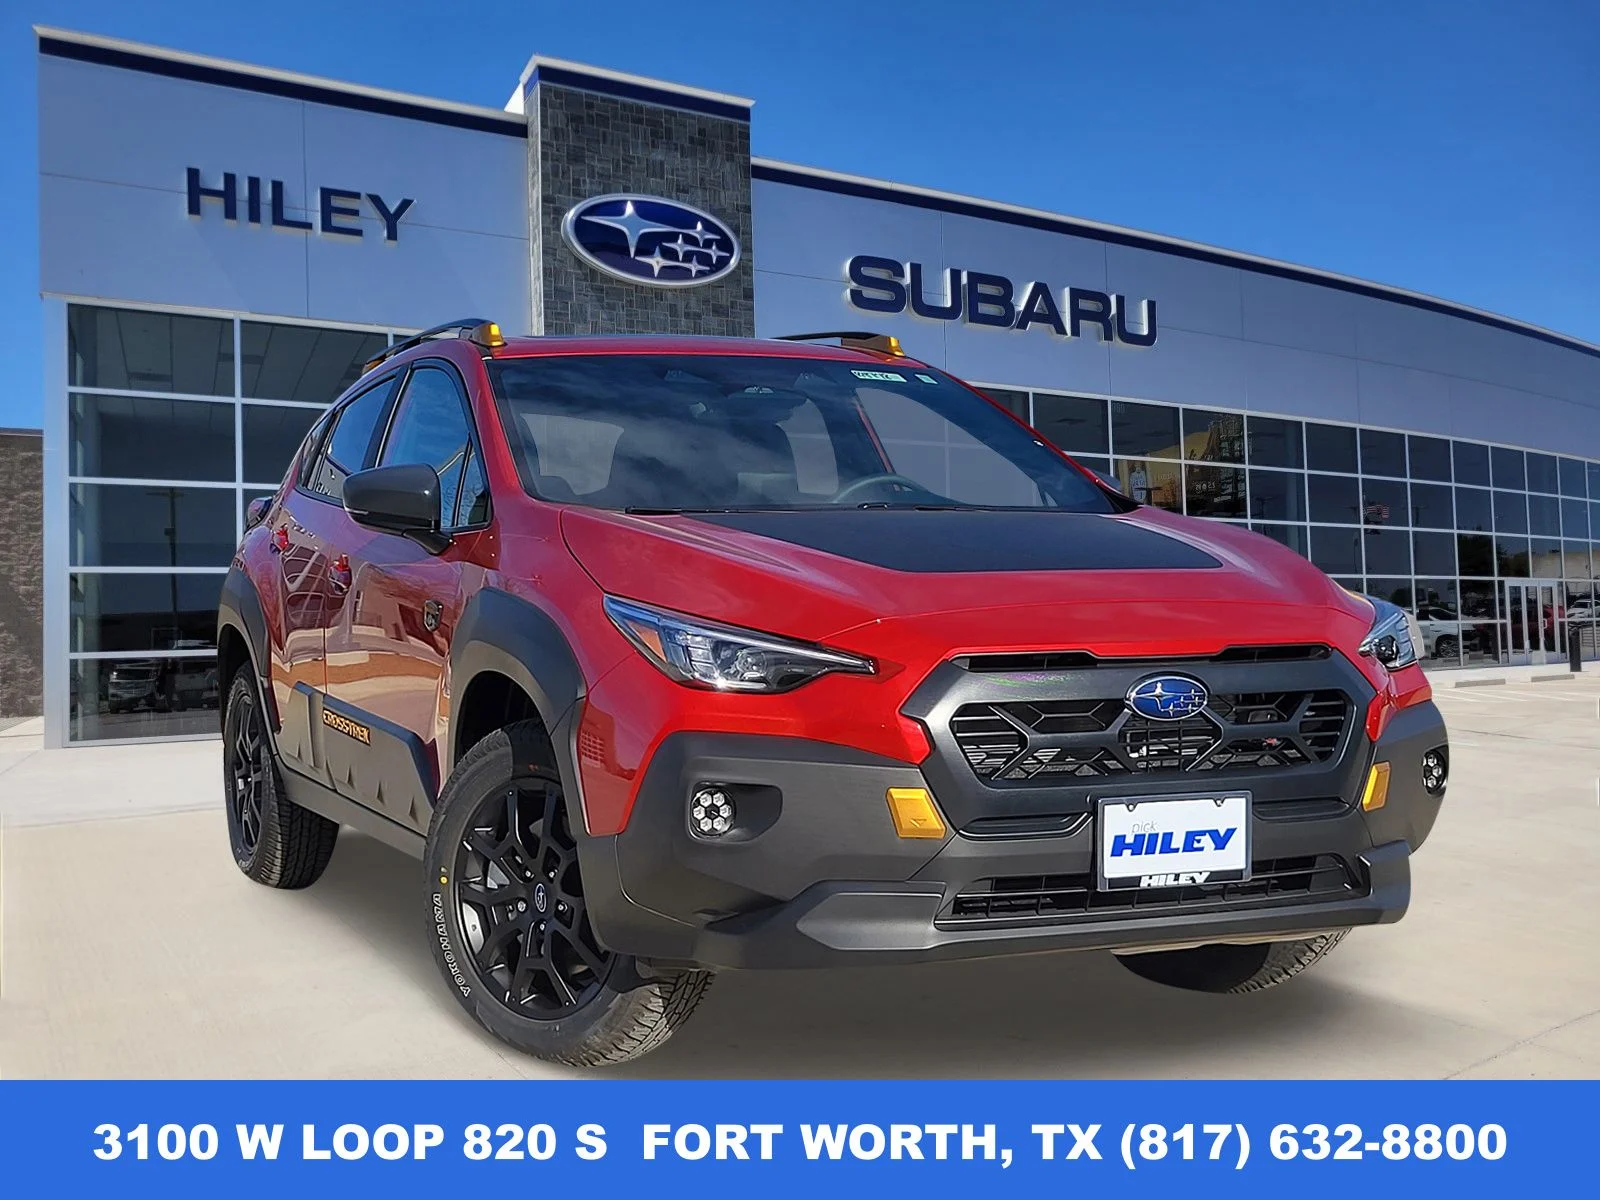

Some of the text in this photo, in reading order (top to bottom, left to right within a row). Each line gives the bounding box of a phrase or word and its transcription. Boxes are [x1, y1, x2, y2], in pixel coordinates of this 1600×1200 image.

[187, 167, 414, 241] HILEY
[848, 255, 1158, 347] SUBARU
[1110, 827, 1238, 857] HILEY
[1131, 820, 1159, 834] pick
[1139, 871, 1211, 888] HILEY
[432, 893, 472, 998] YOKOHAMA
